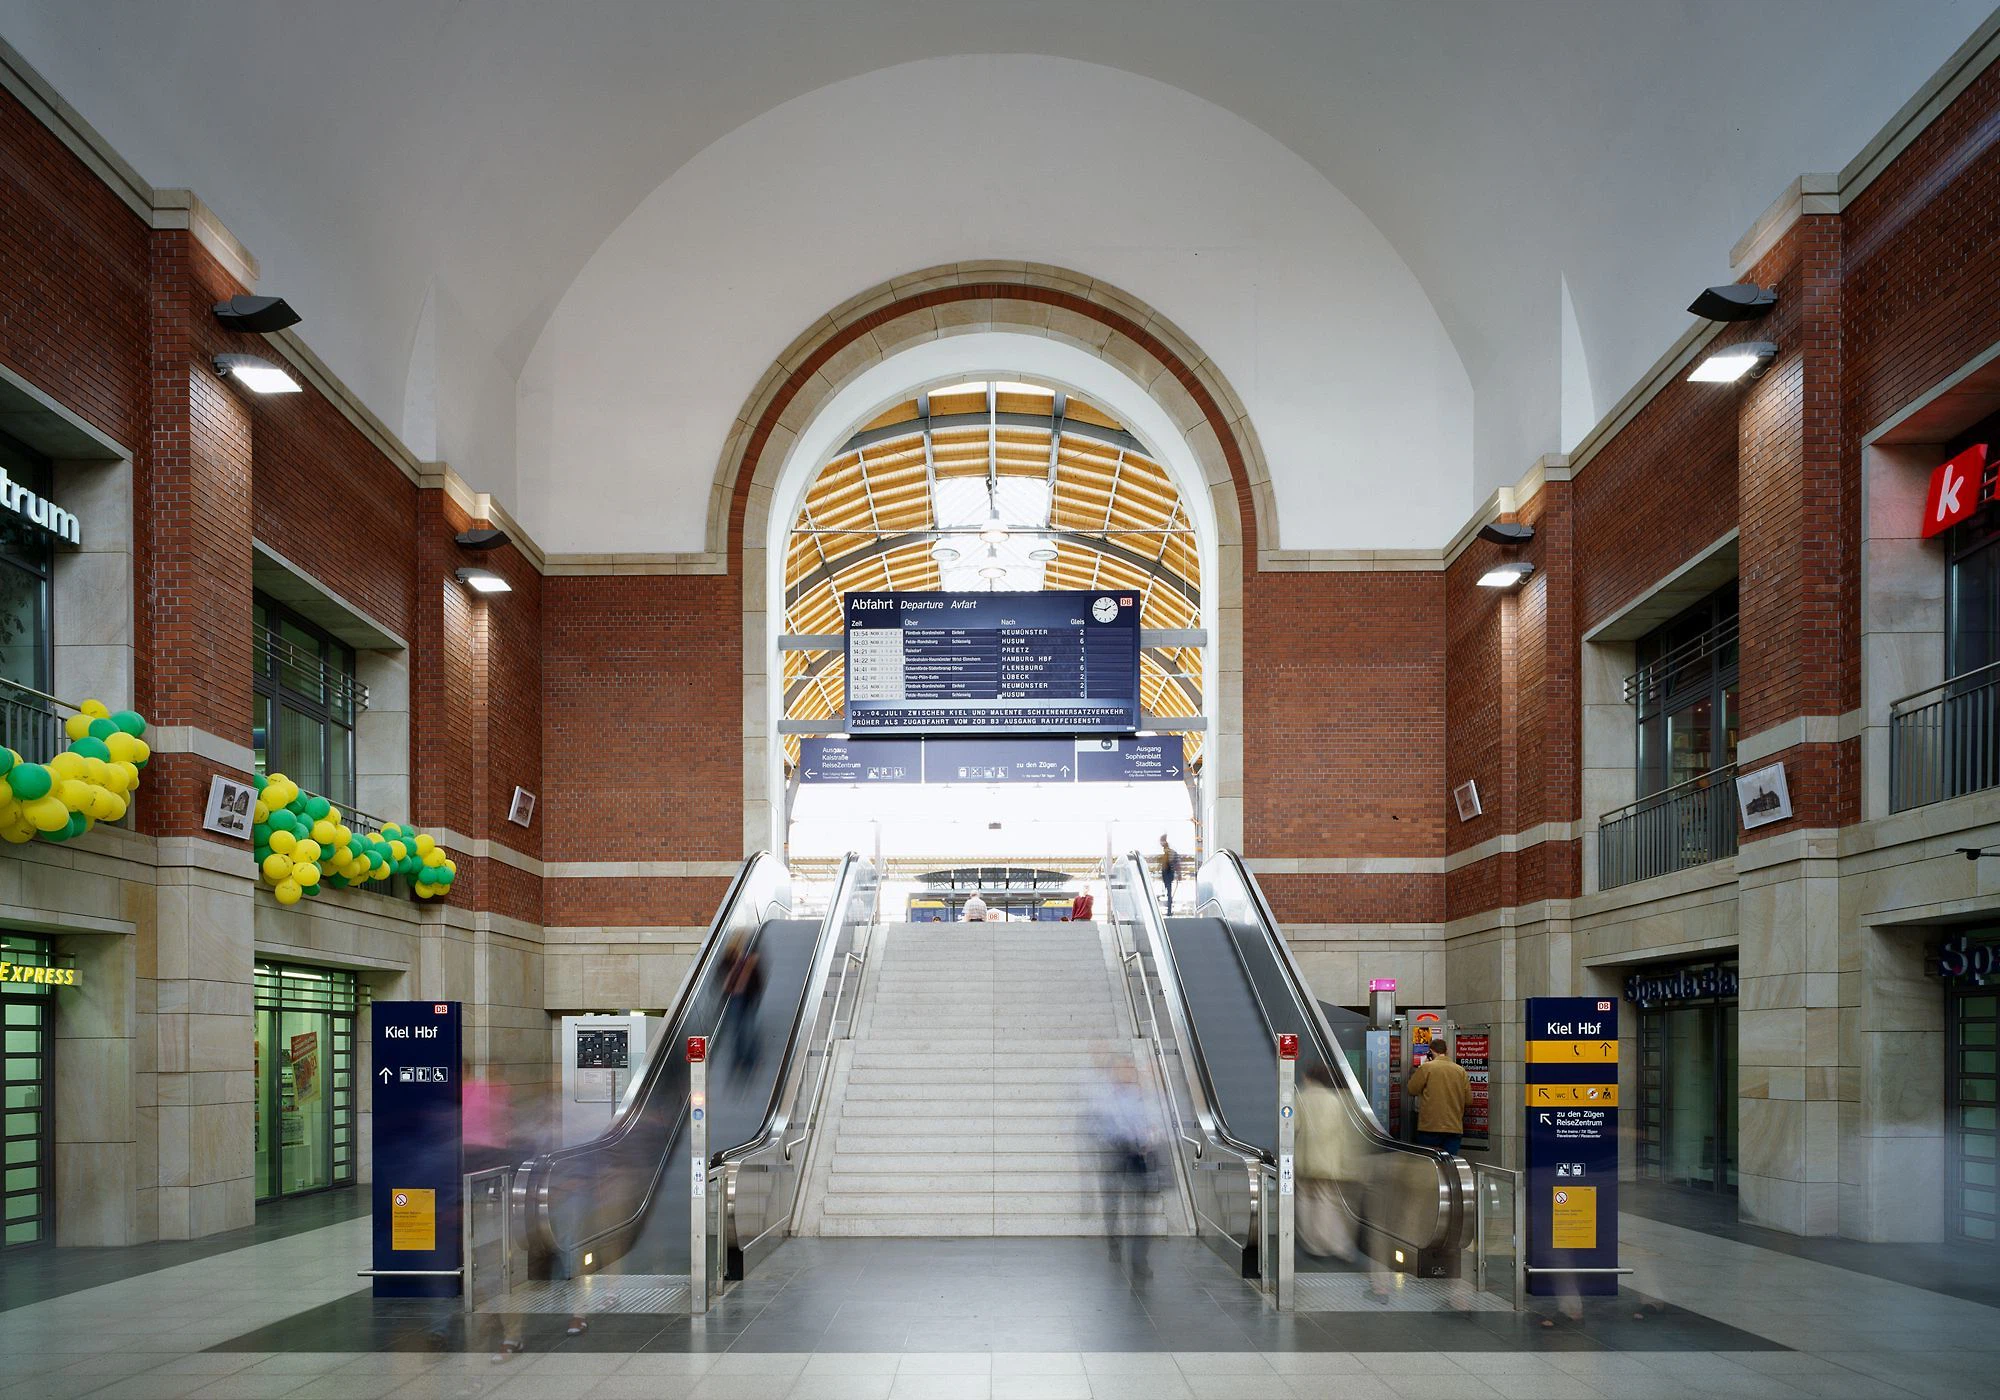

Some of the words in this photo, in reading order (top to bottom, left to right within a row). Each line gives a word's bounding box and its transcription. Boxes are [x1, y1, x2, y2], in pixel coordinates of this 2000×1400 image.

[1936, 464, 1964, 522] k
[0, 466, 80, 544] trum
[851, 599, 894, 610] Abfahrt
[900, 600, 944, 611] Departure
[951, 600, 977, 610] Avfart
[1120, 597, 1132, 607] DB
[1027, 708, 1124, 716] SCHIENENERSATZVERKEHR
[1136, 745, 1162, 753] Ausgang
[1038, 761, 1058, 769] Zügen
[1937, 937, 2000, 986] Sp
[0, 962, 75, 985] EXPRESS
[1598, 1002, 1609, 1010] DB
[385, 1026, 410, 1038] Kiel
[414, 1026, 438, 1038] Hbf
[1547, 1022, 1572, 1035] Kiel
[1578, 1022, 1602, 1035] Hbf
[1583, 1110, 1605, 1119] Zügen
